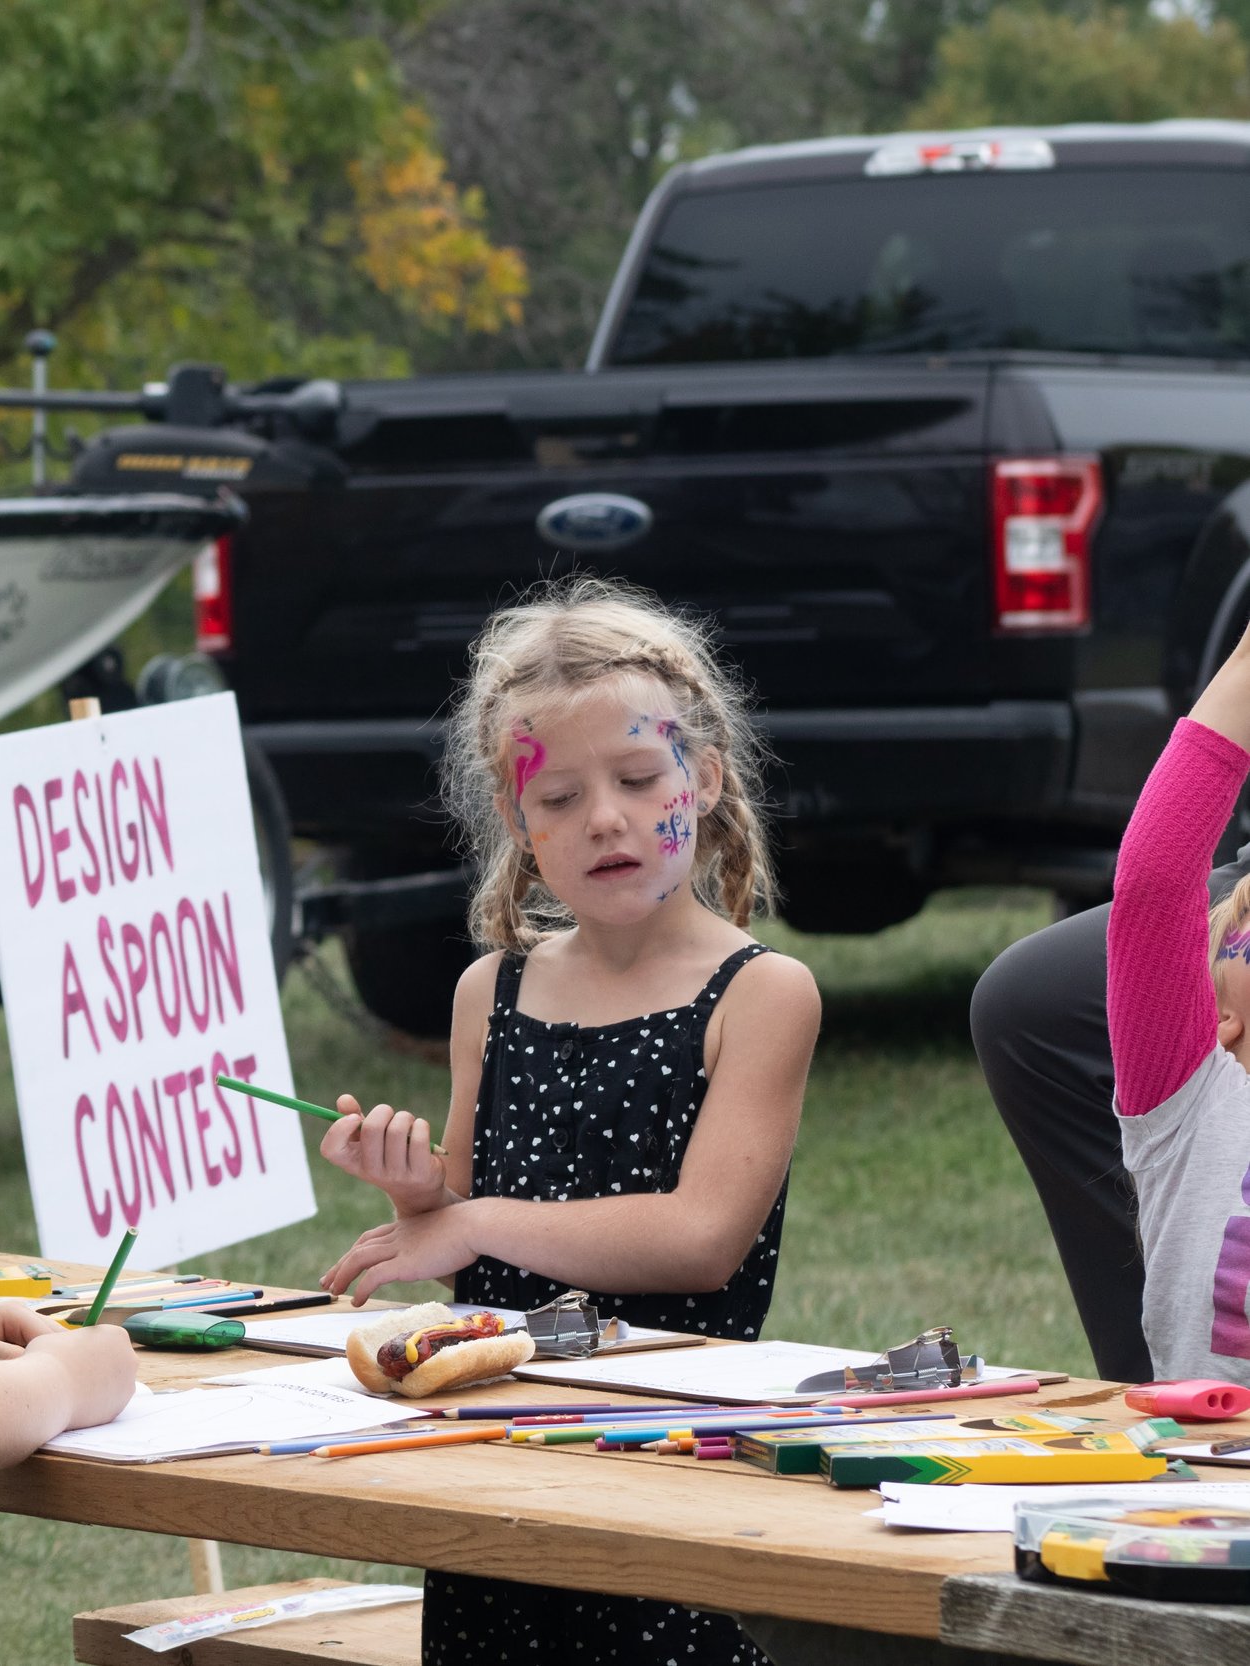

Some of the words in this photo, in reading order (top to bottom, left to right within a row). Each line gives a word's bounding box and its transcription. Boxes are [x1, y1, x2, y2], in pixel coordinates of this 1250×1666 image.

[13, 757, 174, 908] DESIGN
[62, 942, 101, 1059] A
[97, 892, 244, 1043] SPOON
[75, 1051, 266, 1238] CONTEST
